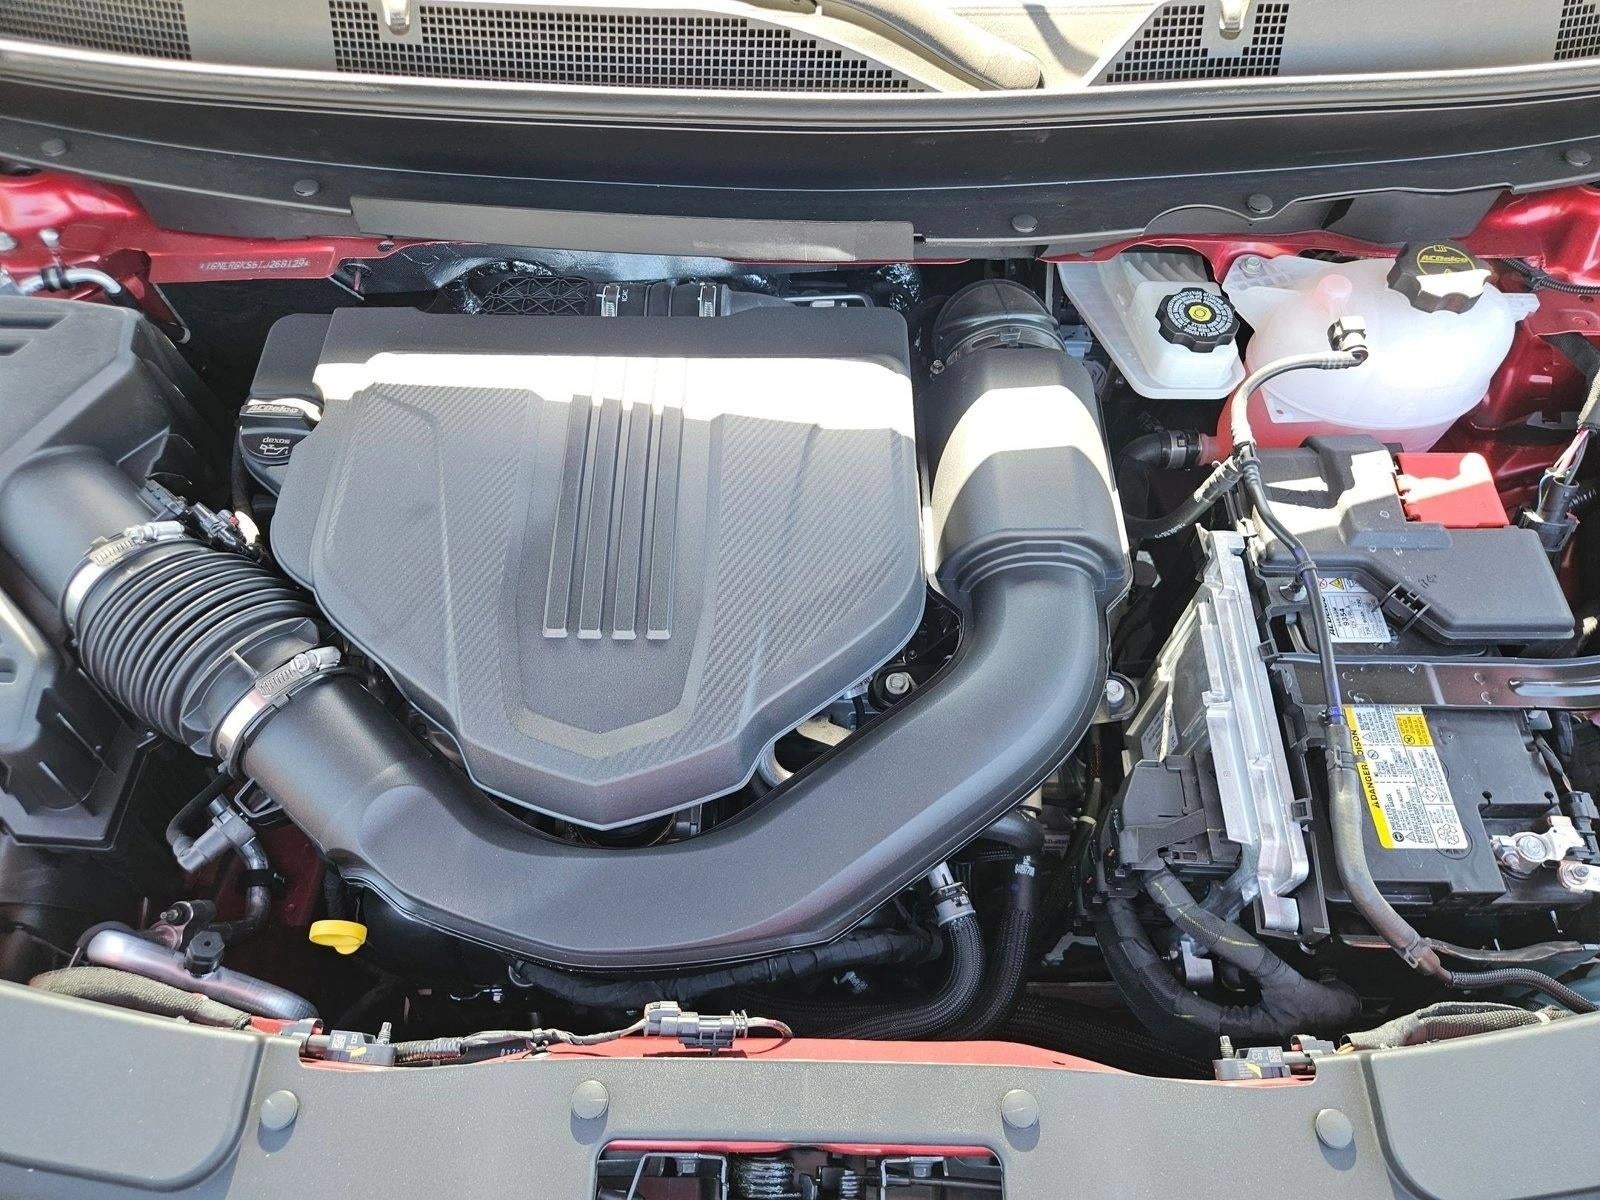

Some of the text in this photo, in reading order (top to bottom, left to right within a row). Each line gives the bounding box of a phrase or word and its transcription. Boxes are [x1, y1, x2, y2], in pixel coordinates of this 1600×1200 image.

[1350, 730, 1378, 800] DANGER OISON
[351, 1034, 358, 1044] B
